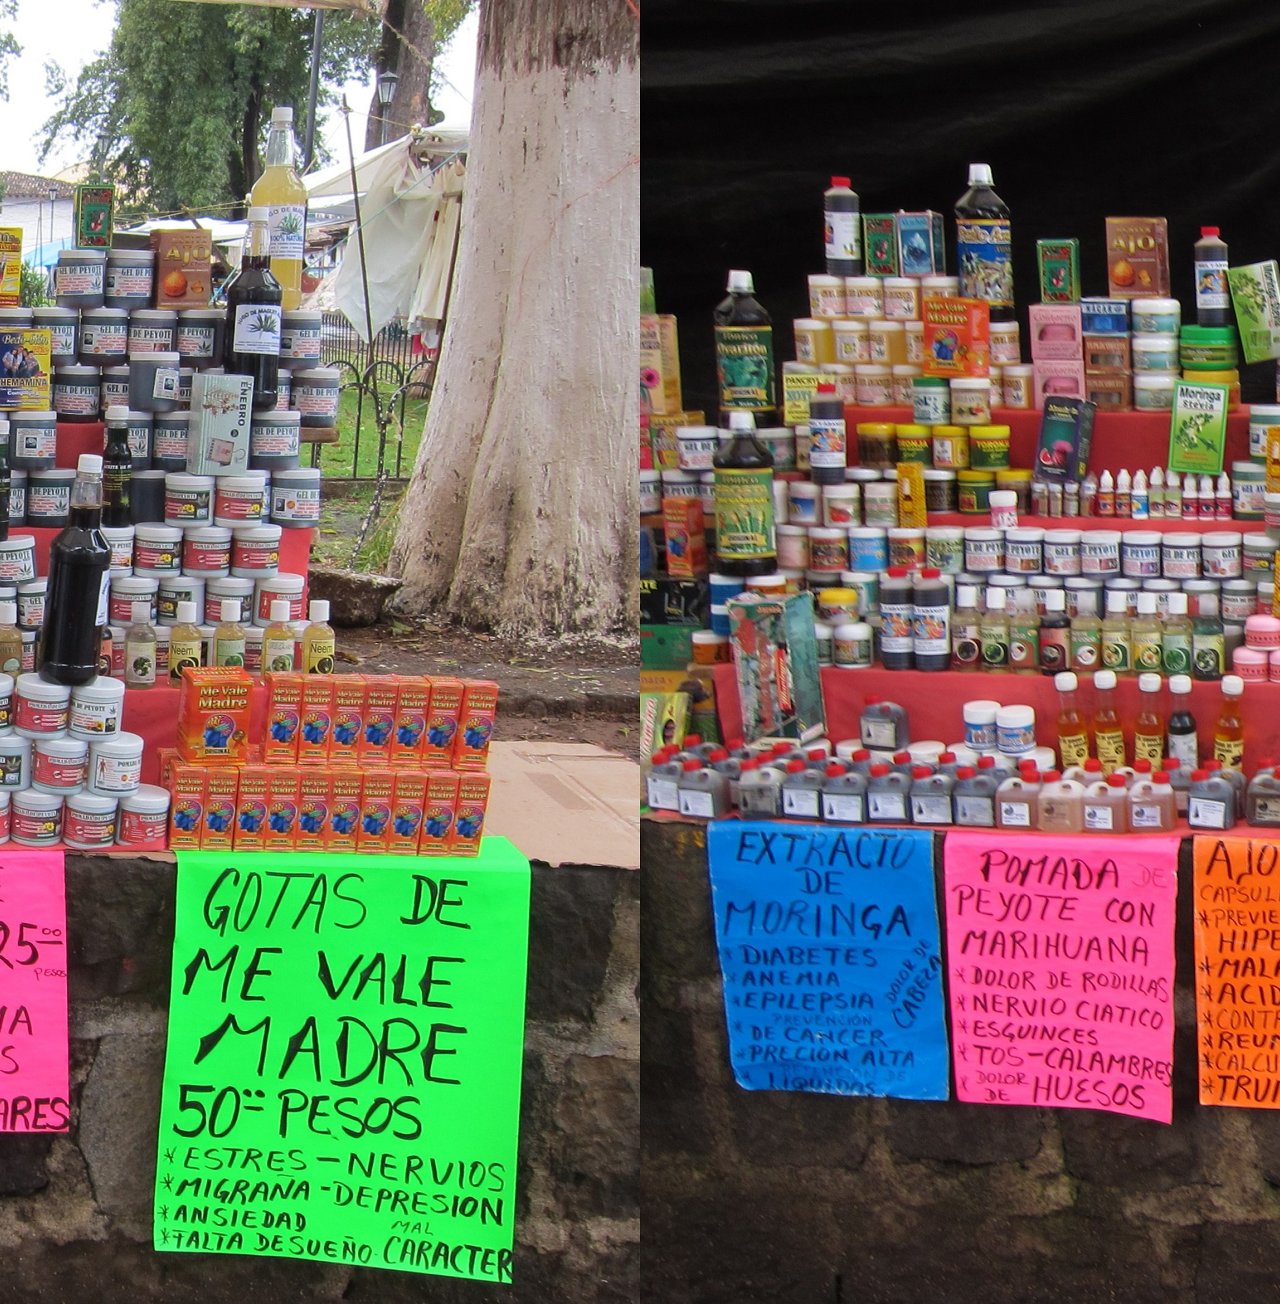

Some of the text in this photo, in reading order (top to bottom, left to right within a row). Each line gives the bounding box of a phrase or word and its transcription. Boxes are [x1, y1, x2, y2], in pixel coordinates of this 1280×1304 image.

[144, 331, 170, 339] PEYOTE
[0, 378, 47, 387] HEMAMINA
[1180, 387, 1221, 403] Moringa
[1183, 400, 1214, 410] Stevia
[171, 645, 193, 656] Neem
[199, 698, 247, 710] Madre
[201, 686, 247, 696] Me Vale
[736, 831, 914, 867] EXTRACTO
[1205, 840, 1279, 883] AJO
[203, 868, 471, 936] GOTAS DE
[952, 884, 1078, 923] PEYOTE
[722, 900, 911, 938] MORINGA
[960, 930, 1149, 967] MARIHUANA
[183, 945, 466, 1008] ME VALE
[194, 1014, 467, 1086] MADRE
[279, 1089, 421, 1139] PESOS
[176, 1173, 309, 1203] MIGRAÑA
[173, 1205, 306, 1232] ANSIEDAD
[392, 1220, 434, 1236] MAL
[171, 1231, 243, 1250] FALTA
[384, 1236, 513, 1282] CARACTER
